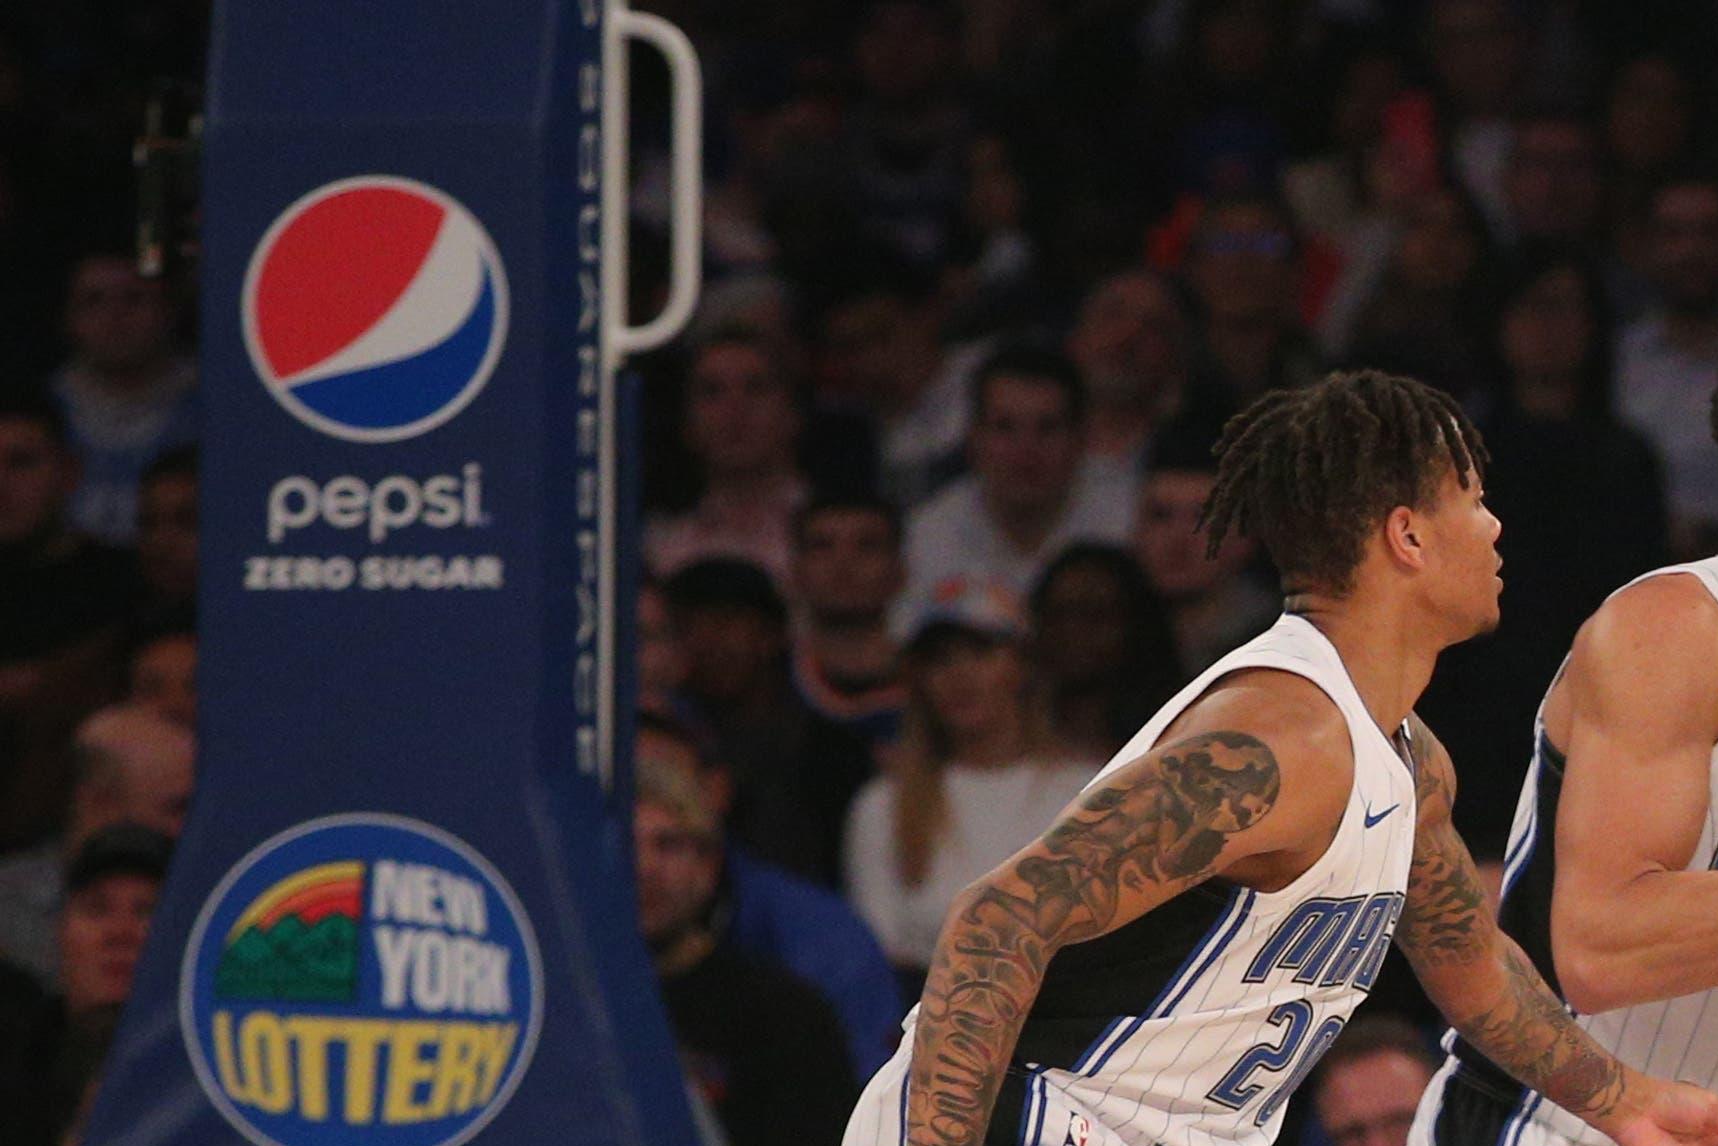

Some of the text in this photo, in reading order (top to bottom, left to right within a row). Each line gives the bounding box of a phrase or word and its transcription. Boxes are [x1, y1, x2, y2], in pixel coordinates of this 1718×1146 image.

[267, 461, 483, 544] pepsi
[244, 555, 504, 591] ZERO SUGAR
[372, 859, 488, 936] NEW
[372, 925, 517, 1016] YORK
[211, 1010, 520, 1126] LOTTERY
